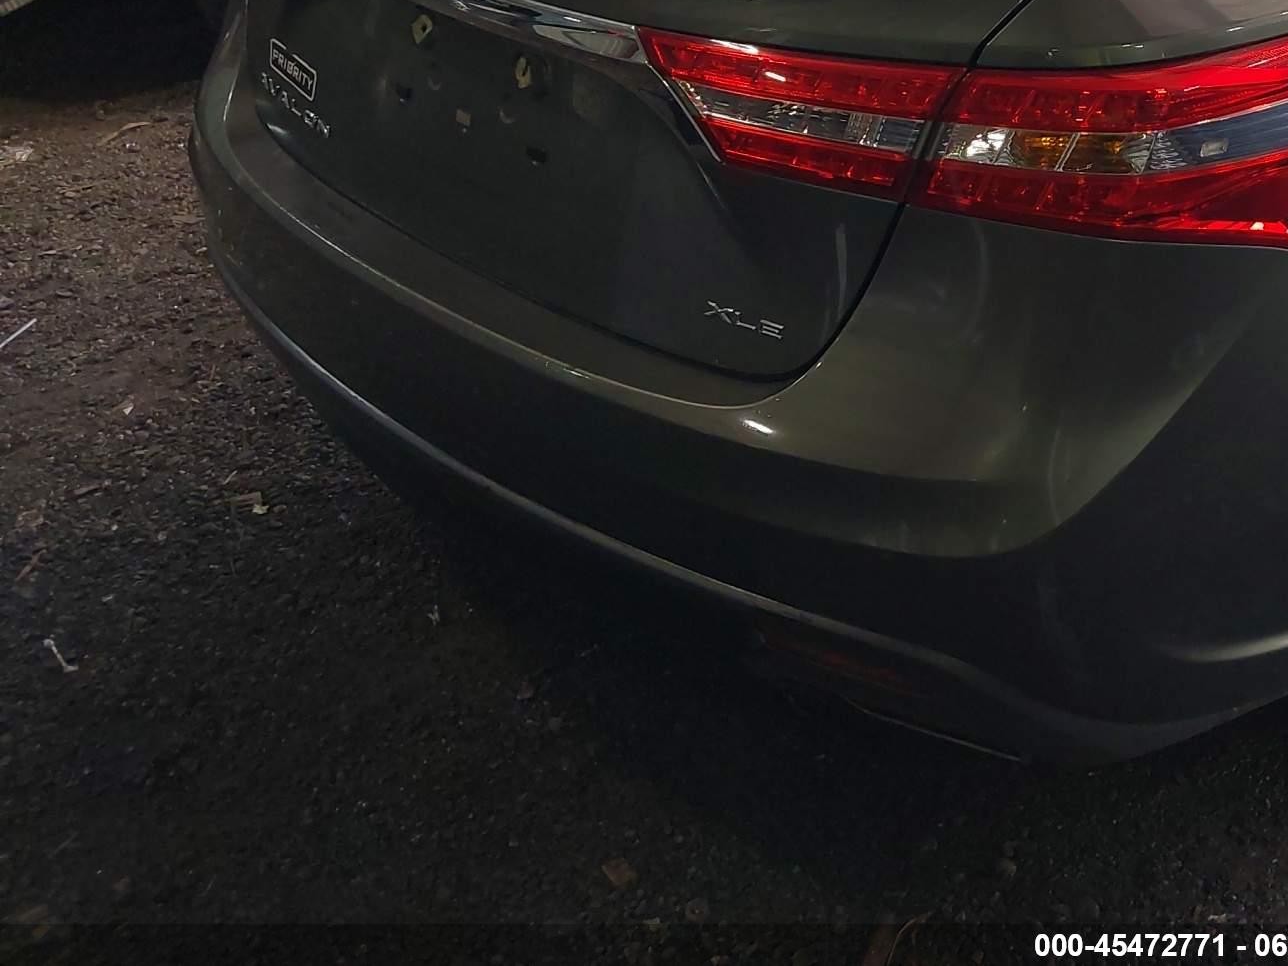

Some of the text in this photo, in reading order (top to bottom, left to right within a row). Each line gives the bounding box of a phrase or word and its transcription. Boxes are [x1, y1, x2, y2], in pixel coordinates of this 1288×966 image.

[271, 48, 314, 91] PRIORITY
[261, 72, 331, 138] AVALON
[704, 300, 784, 339] XLE
